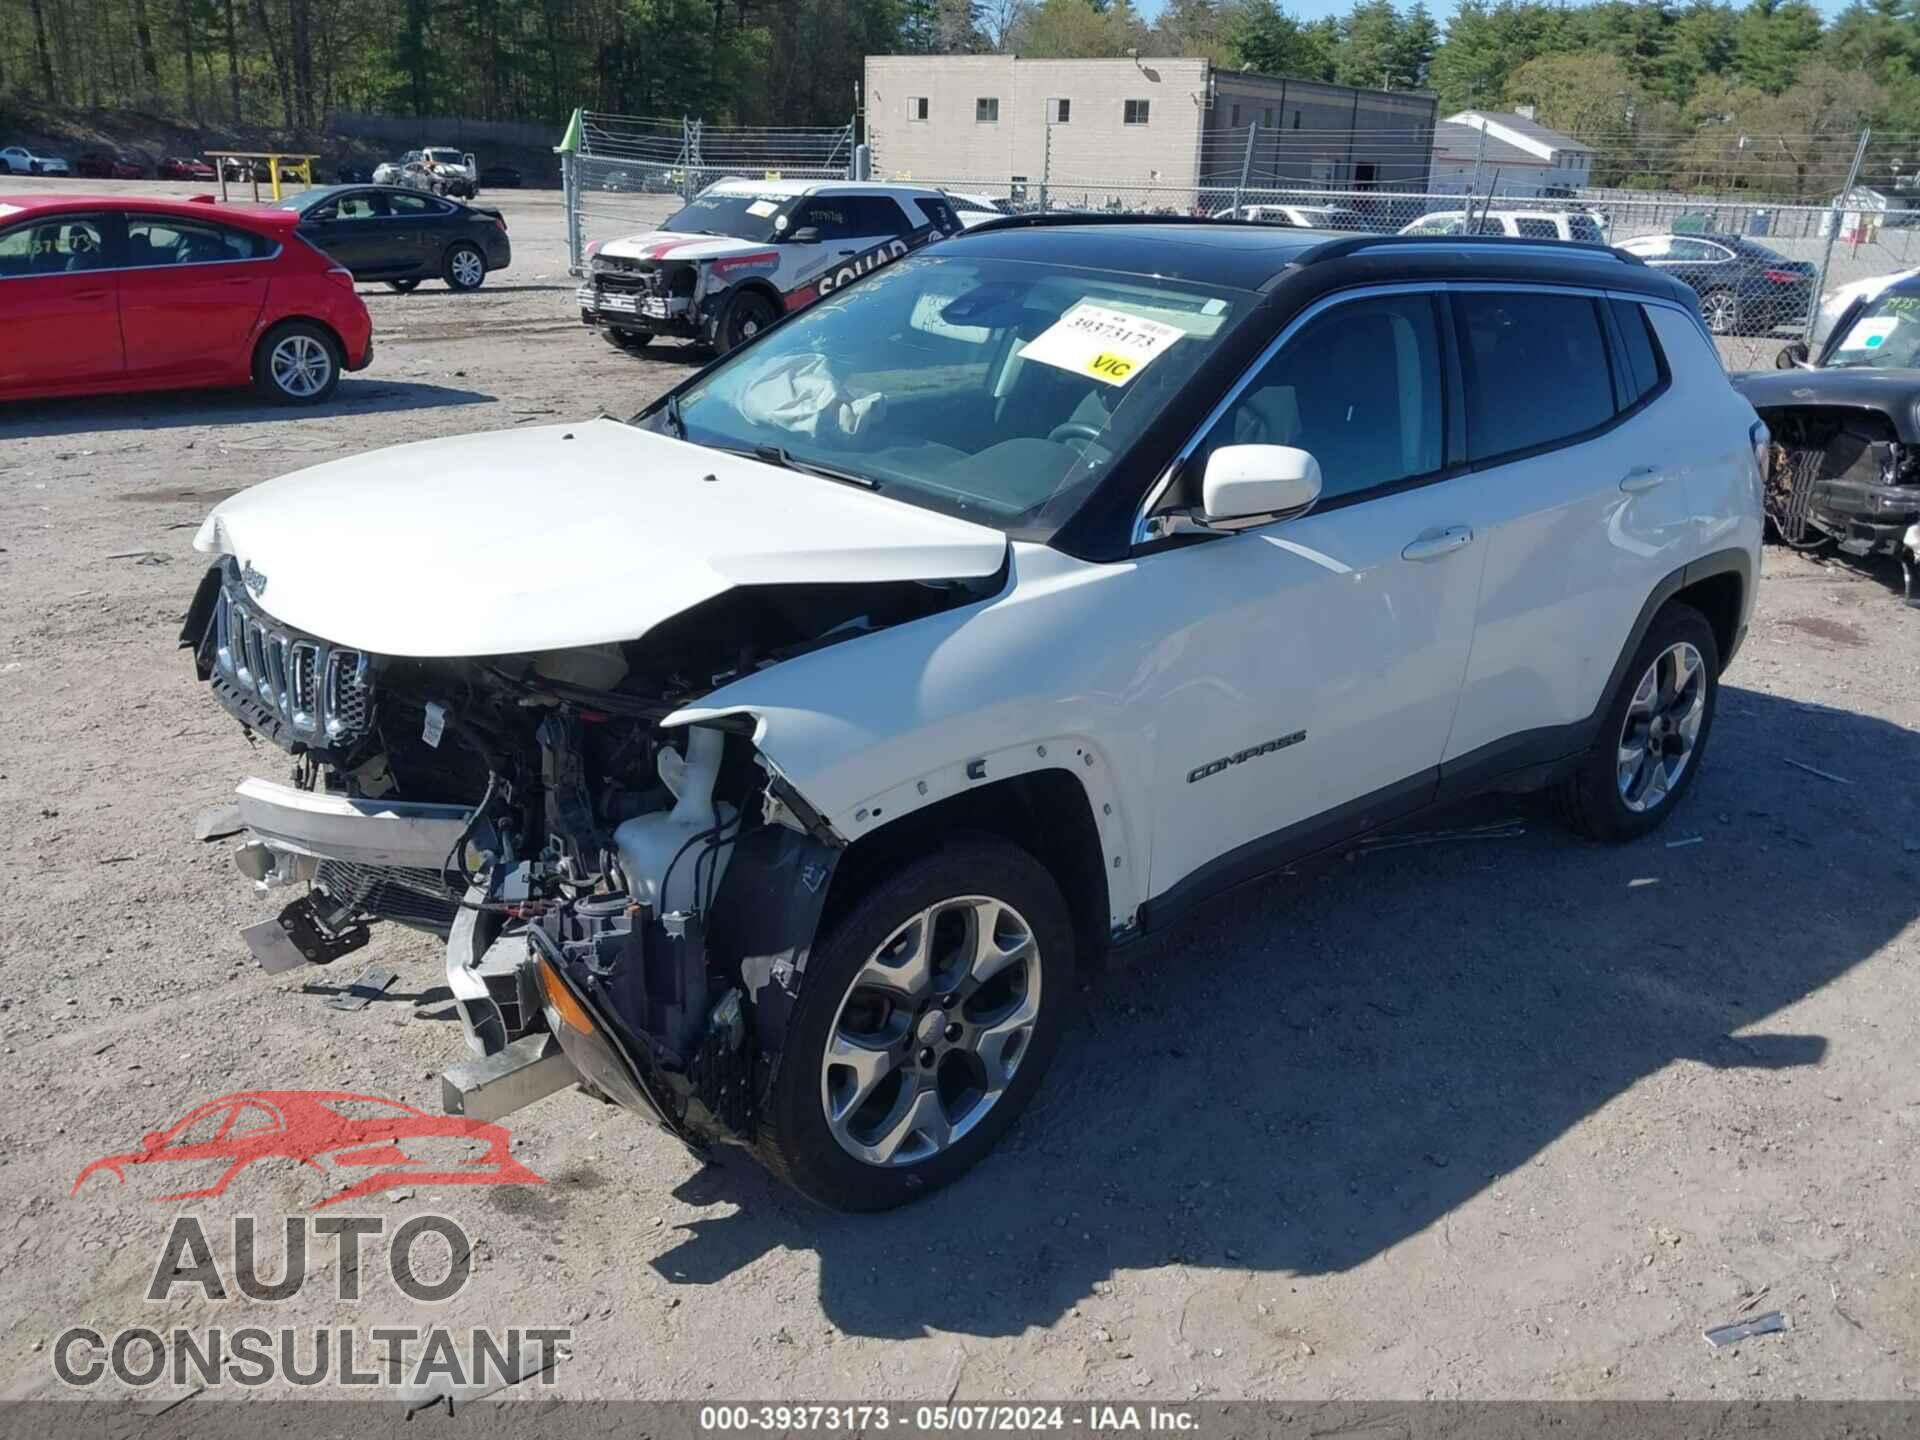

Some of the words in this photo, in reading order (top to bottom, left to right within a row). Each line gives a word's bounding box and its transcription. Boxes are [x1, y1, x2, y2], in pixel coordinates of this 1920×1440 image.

[1066, 317, 1156, 348] 39373173
[1093, 354, 1131, 377] VIC
[1186, 728, 1307, 784] COMPASS
